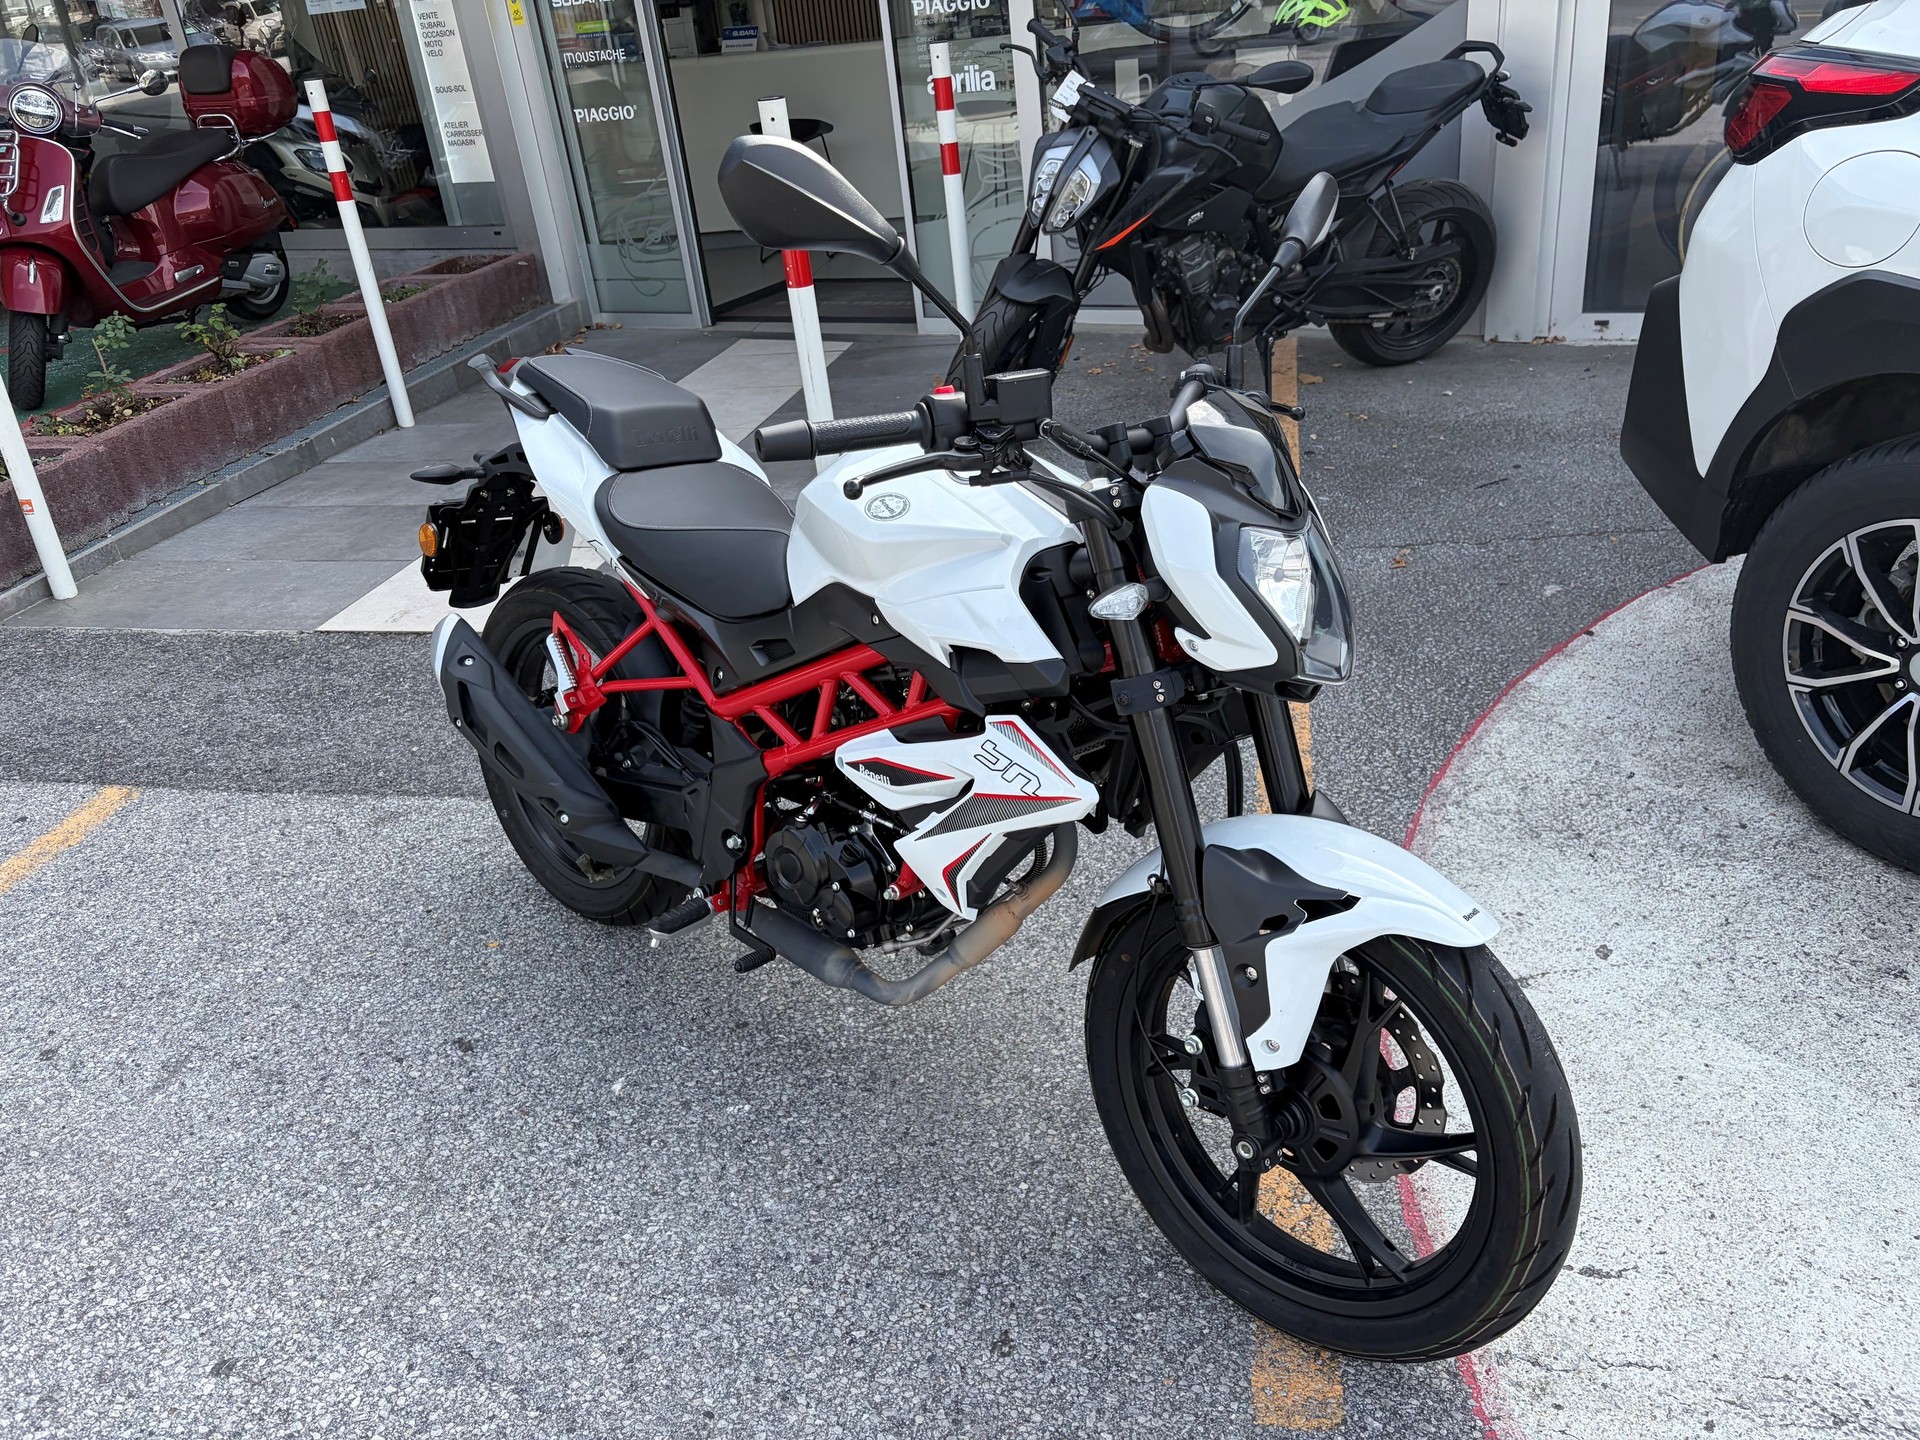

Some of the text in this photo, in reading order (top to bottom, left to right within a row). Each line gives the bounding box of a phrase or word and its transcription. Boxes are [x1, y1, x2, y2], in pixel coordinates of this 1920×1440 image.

[418, 11, 439, 20] VENTE
[420, 21, 446, 30] SUBARU
[422, 29, 455, 39] OCCASION
[424, 40, 443, 48] MOTO
[426, 49, 444, 57] VELO
[435, 84, 467, 94] SOUS-SOL
[573, 105, 636, 123] PIAGGIO
[444, 121, 469, 129] ATELIER
[445, 129, 485, 138] CARROSSER
[447, 138, 476, 147] MAGASIN
[858, 763, 891, 786] Benelli
